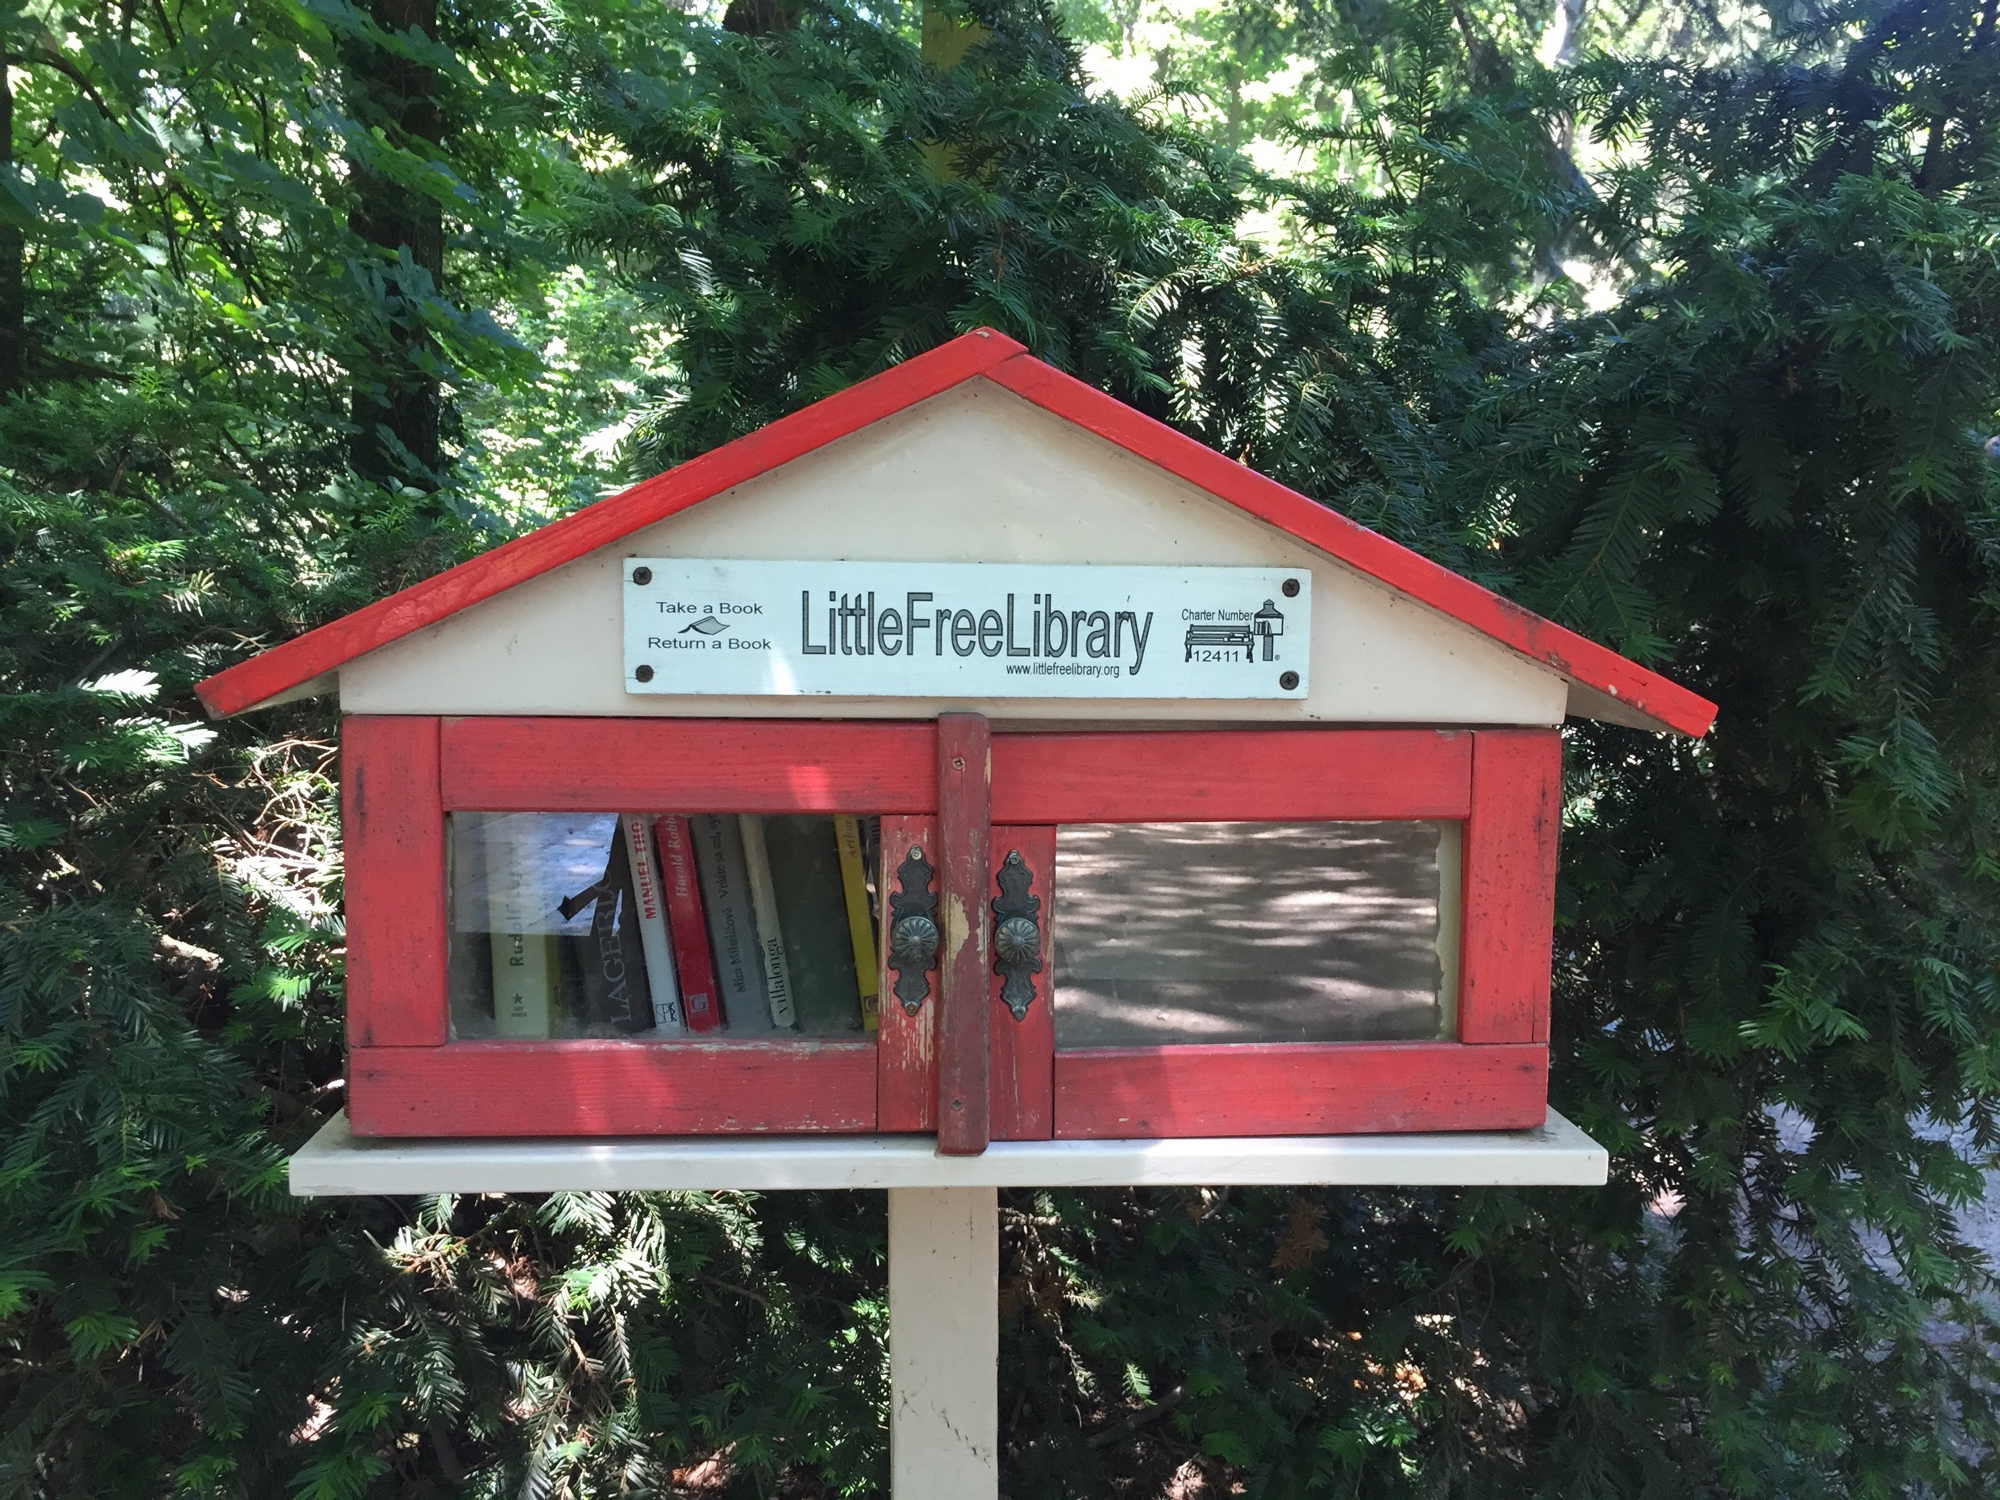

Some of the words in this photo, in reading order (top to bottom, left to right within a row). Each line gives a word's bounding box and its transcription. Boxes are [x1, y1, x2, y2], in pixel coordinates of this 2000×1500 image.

[656, 601, 697, 614] Take
[703, 604, 714, 614] a
[719, 602, 764, 615] Book
[1181, 608, 1216, 621] Charter
[1218, 608, 1254, 621] Number
[801, 590, 1154, 676] LittleFreeLibrary
[648, 636, 706, 650] Return
[712, 640, 722, 650] a
[728, 638, 772, 650] Book
[1193, 650, 1239, 663] 12411
[1006, 661, 1120, 679] www.littlefreelibrary.org
[630, 819, 648, 853] THO
[665, 814, 681, 847] Robb
[636, 860, 658, 920] MANUEL
